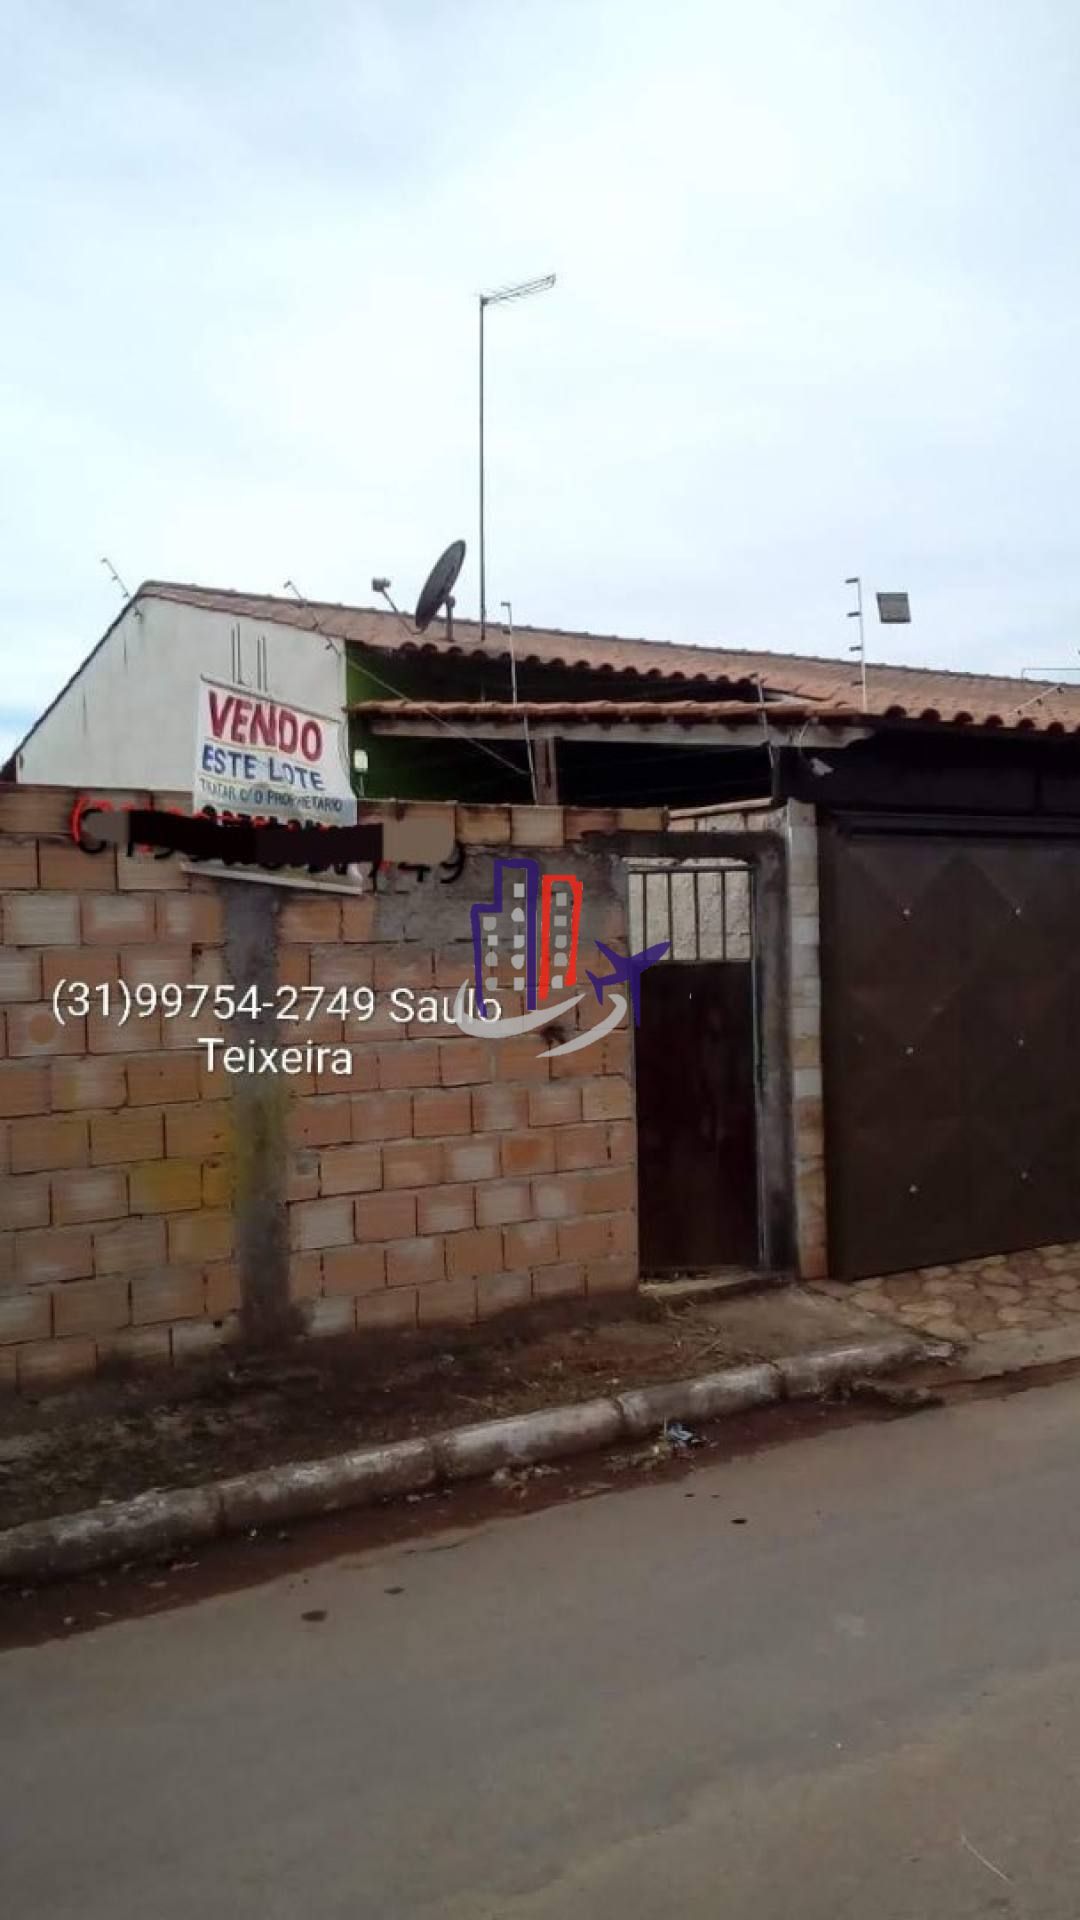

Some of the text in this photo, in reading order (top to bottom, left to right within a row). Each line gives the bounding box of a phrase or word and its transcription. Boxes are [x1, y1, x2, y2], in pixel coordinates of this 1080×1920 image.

[208, 689, 323, 762] VENDO
[202, 744, 325, 791] ESTE LOTE
